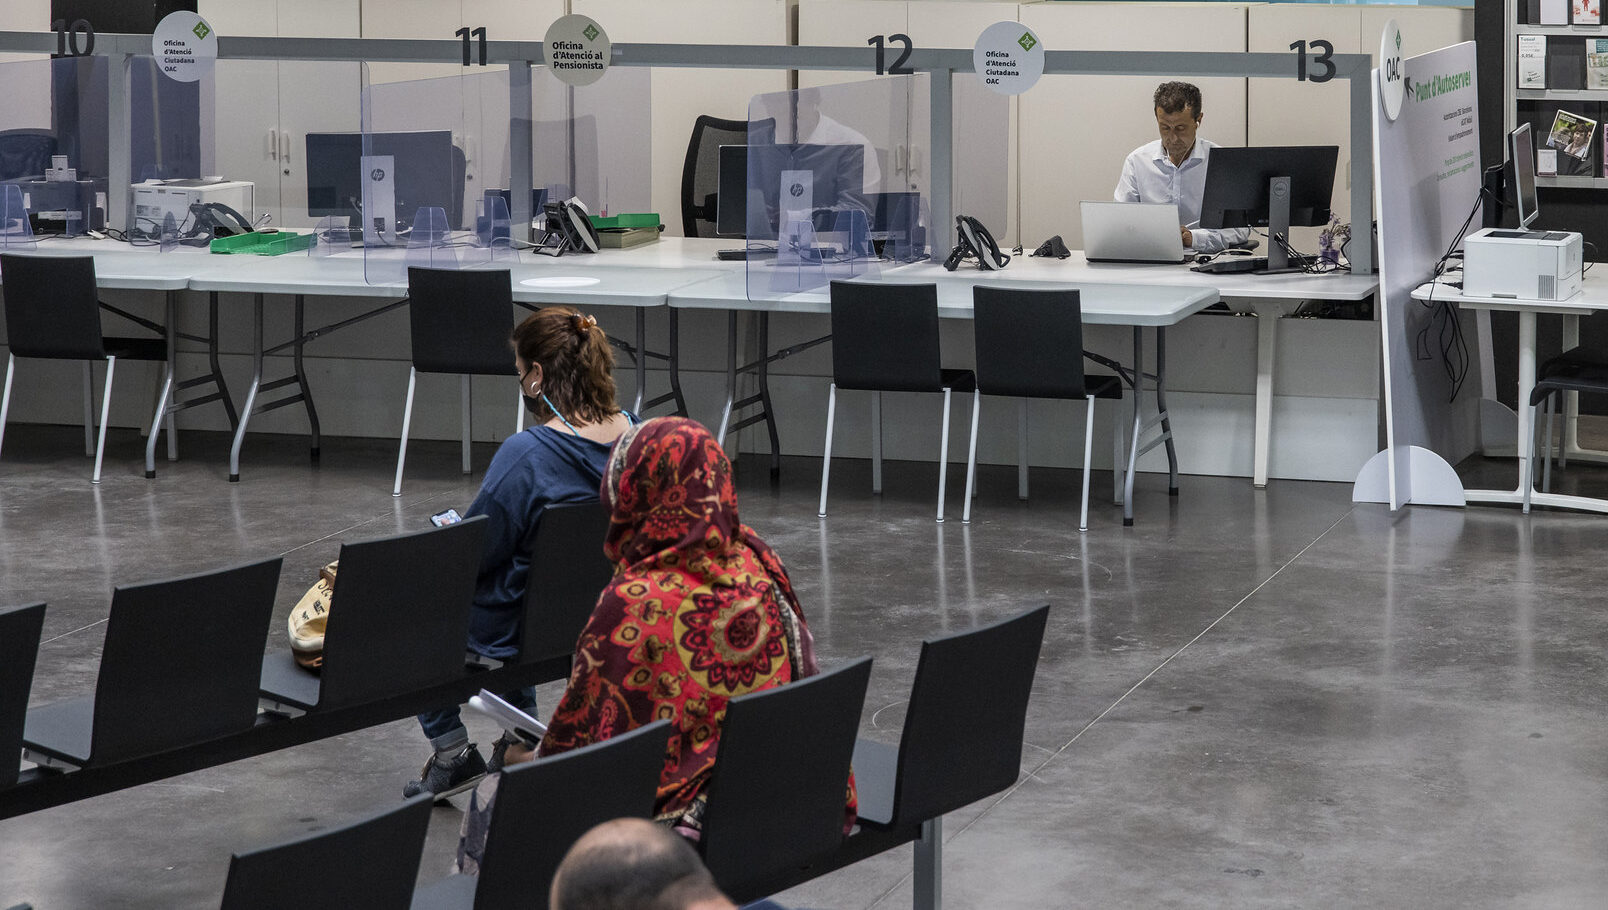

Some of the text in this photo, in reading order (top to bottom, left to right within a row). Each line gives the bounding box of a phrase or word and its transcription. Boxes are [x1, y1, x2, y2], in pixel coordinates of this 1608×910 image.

[52, 19, 95, 57] 10
[455, 27, 487, 66] 11
[552, 41, 583, 50] Oficina
[554, 60, 604, 70] Pensionista
[594, 51, 603, 60] al
[868, 34, 914, 75] 12
[1290, 40, 1336, 83] 13
[1386, 56, 1401, 83] OAC
[1415, 80, 1431, 103] Punt
